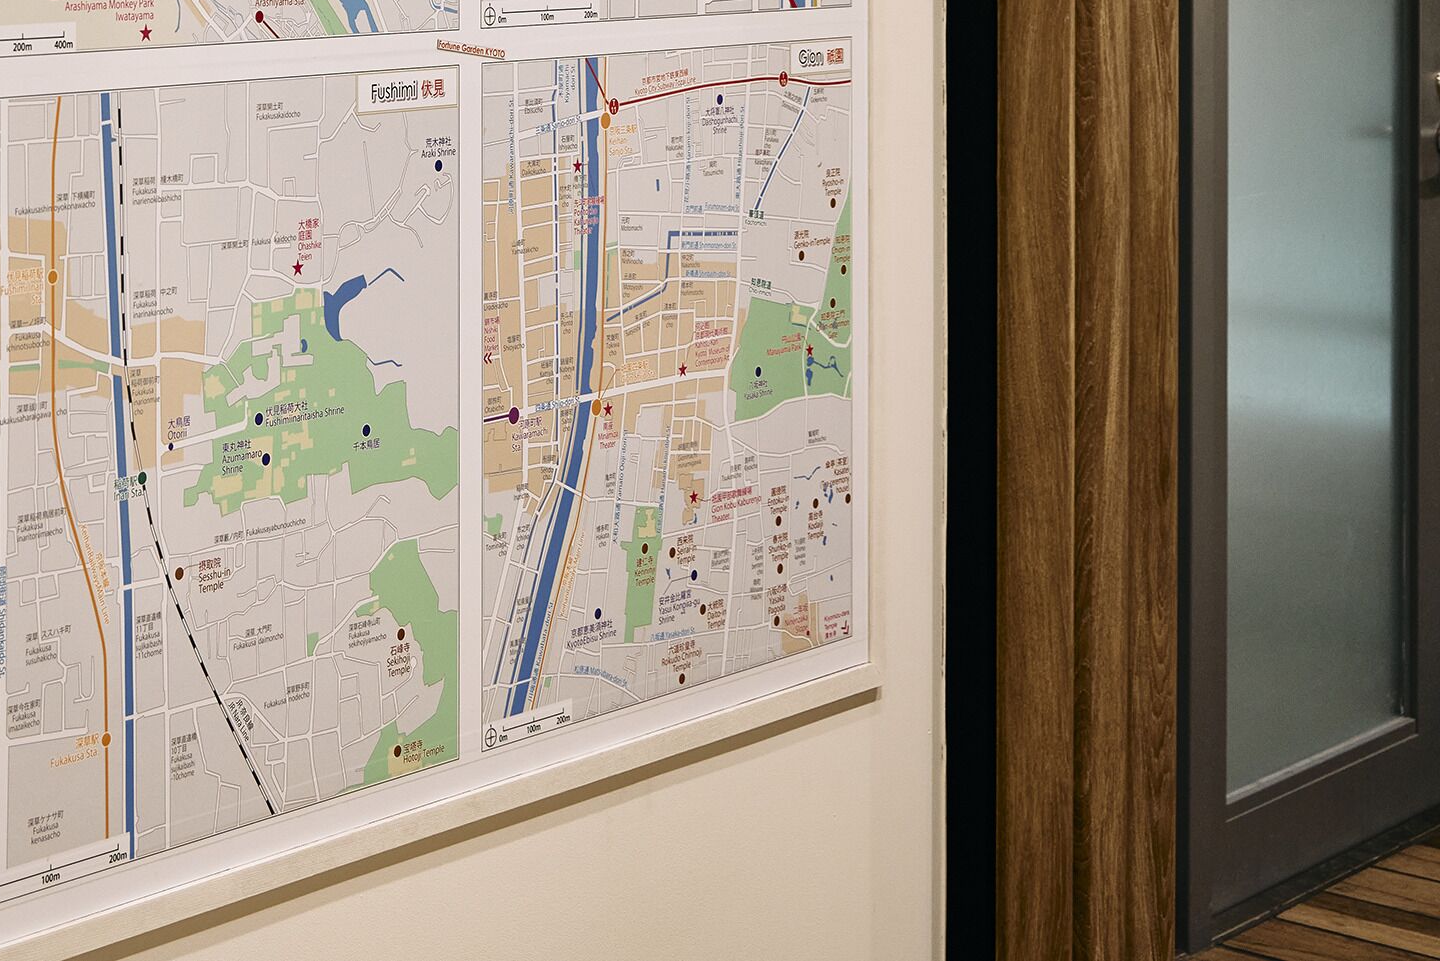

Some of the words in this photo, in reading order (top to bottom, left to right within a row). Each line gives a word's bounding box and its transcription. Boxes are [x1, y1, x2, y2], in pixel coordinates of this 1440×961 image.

[65, 1, 108, 13] Arashiyama
[109, 0, 137, 10] Monkey
[138, 0, 154, 8] Park
[116, 12, 154, 22] Iwatayama
[498, 15, 507, 23] 0m
[540, 13, 554, 21] 100m
[584, 11, 598, 19] 200m
[13, 43, 32, 52] 200m
[54, 40, 73, 49] 400m
[438, 40, 460, 51] Fortune
[462, 43, 484, 56] Garden
[485, 45, 505, 58] KYOTO
[799, 50, 824, 66] Gion
[371, 81, 418, 103] Fushimi
[421, 79, 445, 96] 伏見
[426, 137, 451, 147] 荒木神社
[421, 149, 436, 158] Araki
[437, 147, 456, 157] Shrine
[298, 218, 319, 230] 大橋家
[298, 241, 321, 251] Ohashike
[298, 252, 312, 261] Teien
[265, 401, 308, 416] 伏見稲荷大社
[325, 406, 344, 418] Shrine
[168, 416, 190, 428] 大鳥居
[168, 429, 187, 441] Otorii
[512, 427, 547, 440] Kawaramachi
[223, 439, 251, 452] 東丸神社
[353, 439, 380, 451] 千本鳥居
[222, 449, 262, 465] Azumamaro
[222, 464, 243, 475] Shrine
[198, 568, 230, 581] Sesshu-in
[199, 581, 224, 593] Temple
[635, 576, 655, 586] Temple
[599, 629, 616, 640] Shrine
[390, 644, 410, 655] 石峰寺
[387, 654, 410, 667] Sekihoji
[673, 659, 691, 670] Temple
[388, 666, 410, 677] Temple
[231, 709, 242, 724] Nara
[240, 723, 250, 741] Line
[527, 724, 541, 733] 100m
[556, 715, 570, 724] 200m
[422, 745, 444, 758] Temple
[33, 822, 58, 835] Fukakusa
[42, 873, 60, 885] 100m
[110, 852, 127, 863] 200m
